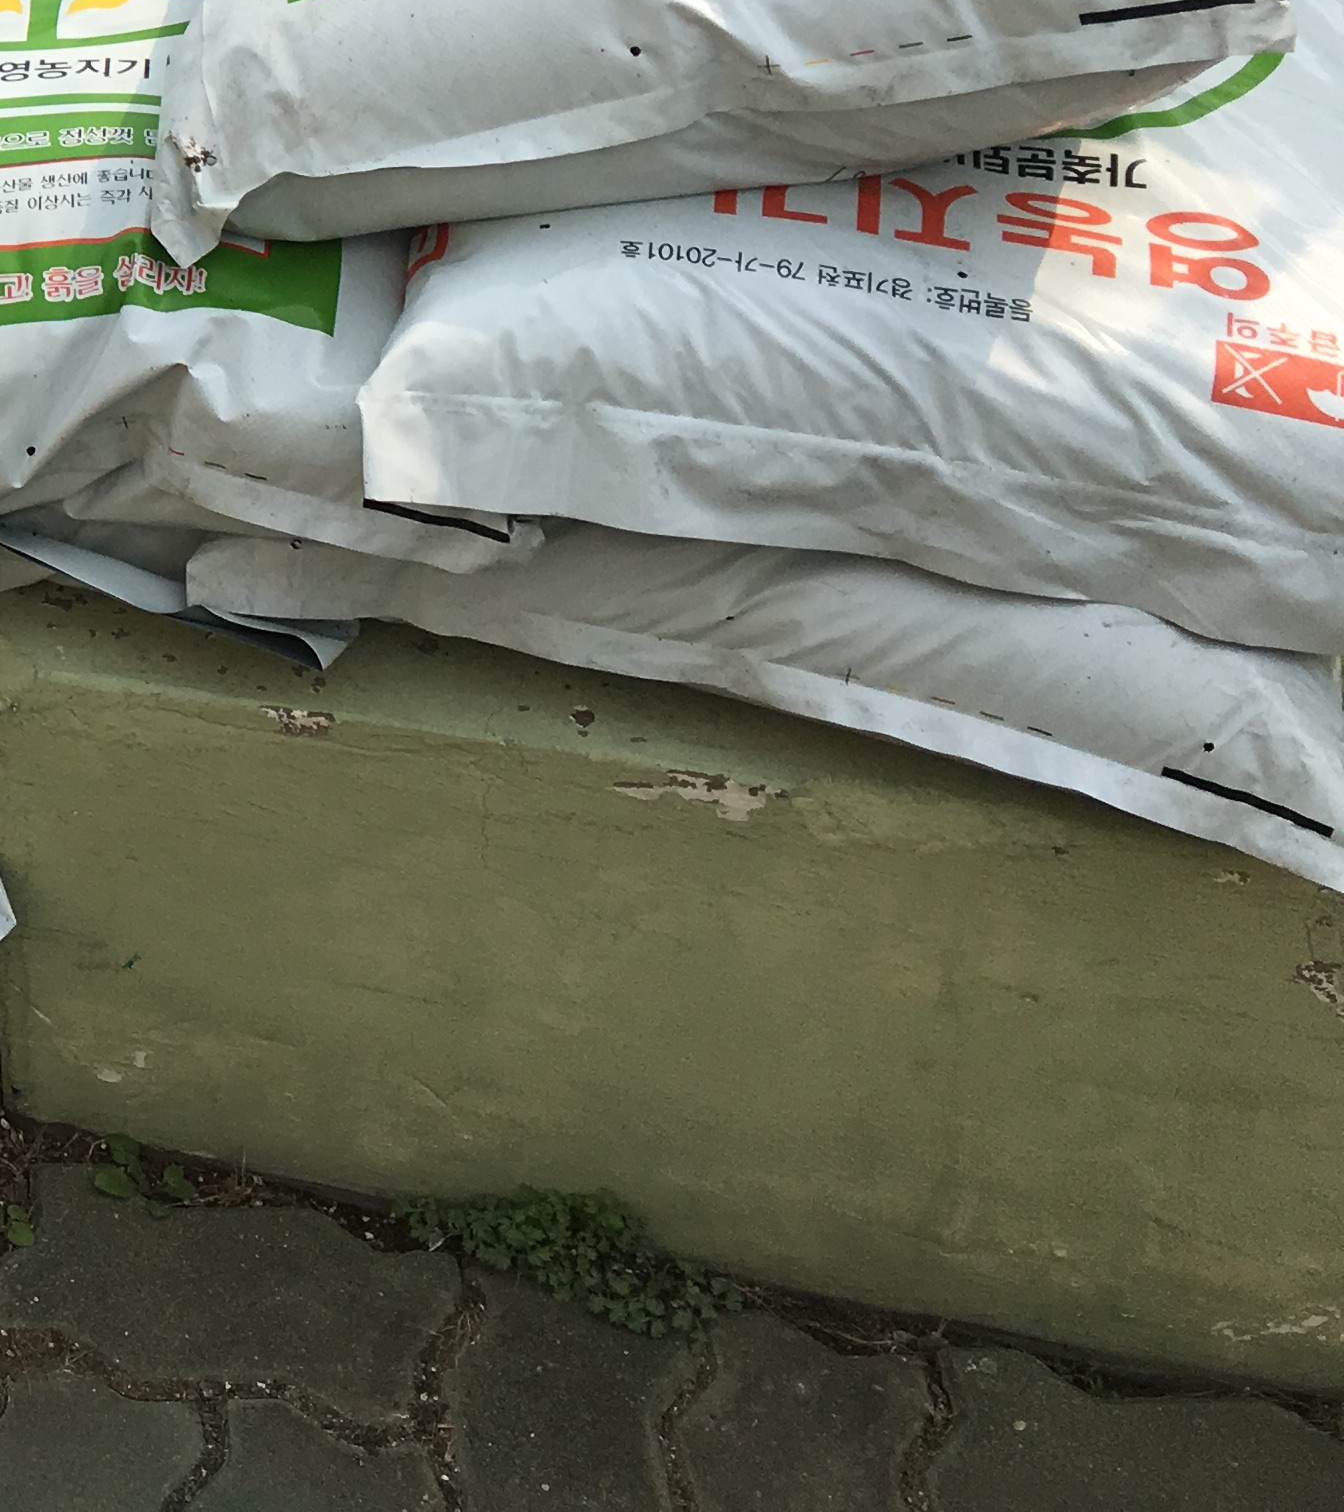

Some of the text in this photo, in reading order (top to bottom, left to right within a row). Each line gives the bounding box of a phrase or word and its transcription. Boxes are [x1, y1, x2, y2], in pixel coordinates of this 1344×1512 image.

[58, 126, 134, 148] 정성껏
[40, 171, 88, 188] 생산에
[27, 191, 91, 211] 이상시는
[100, 187, 131, 205] 즉각
[43, 266, 104, 299] 흙을
[115, 252, 208, 295] 살리자!
[618, 238, 1034, 324] 등록번호: 경기포천 79-가-20101호
[1226, 312, 1341, 359] 급주의
